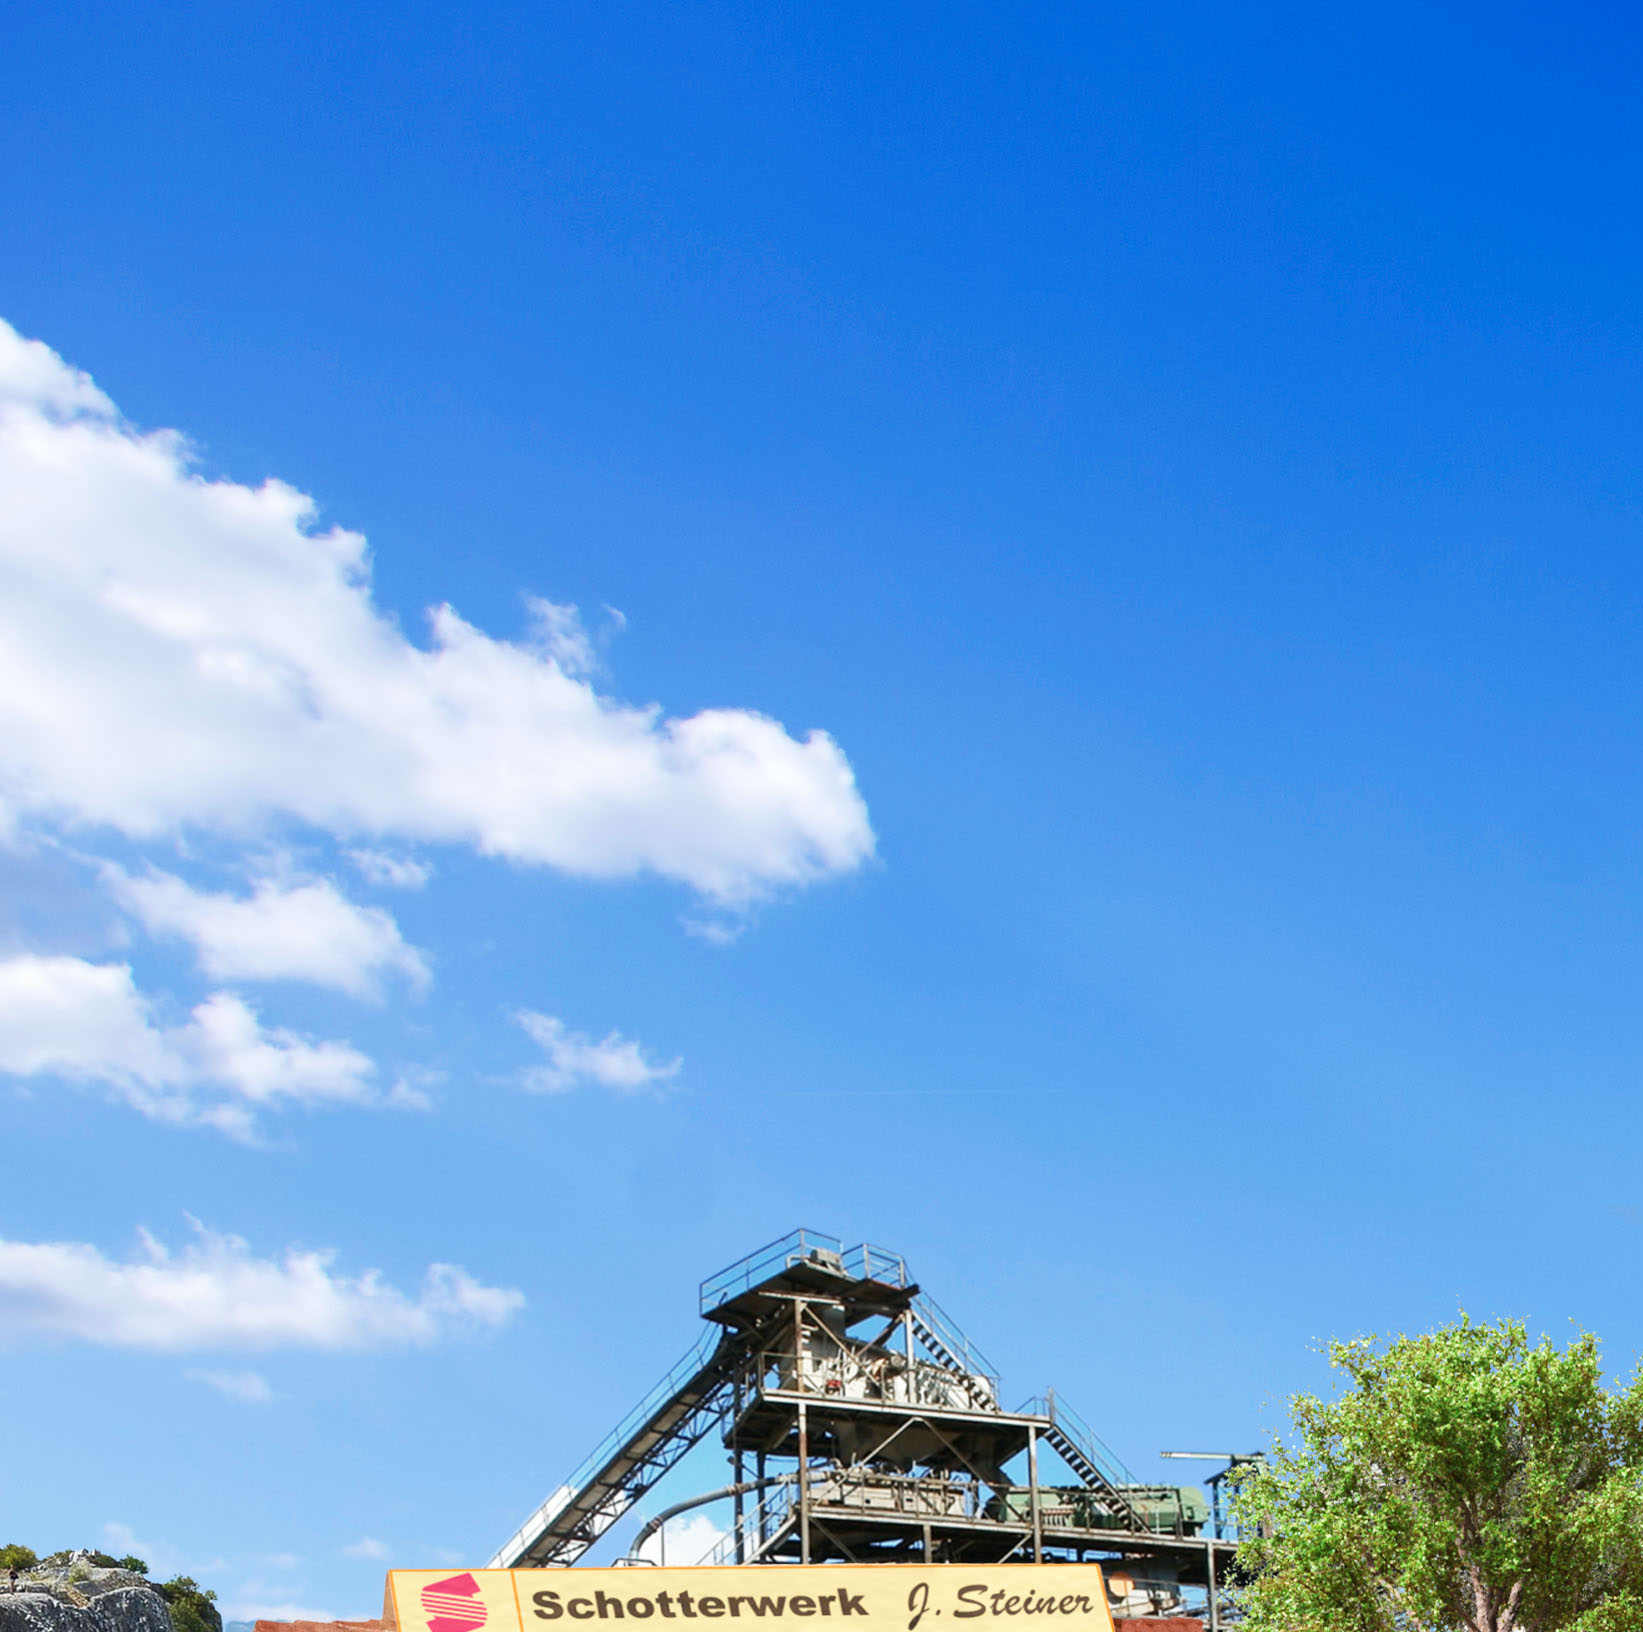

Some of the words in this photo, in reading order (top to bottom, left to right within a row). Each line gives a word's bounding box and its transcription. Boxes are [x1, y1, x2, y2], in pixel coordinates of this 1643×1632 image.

[532, 1588, 869, 1620] Schotterwerk
[908, 1582, 941, 1631] J.
[953, 1584, 1094, 1618] Steiner
